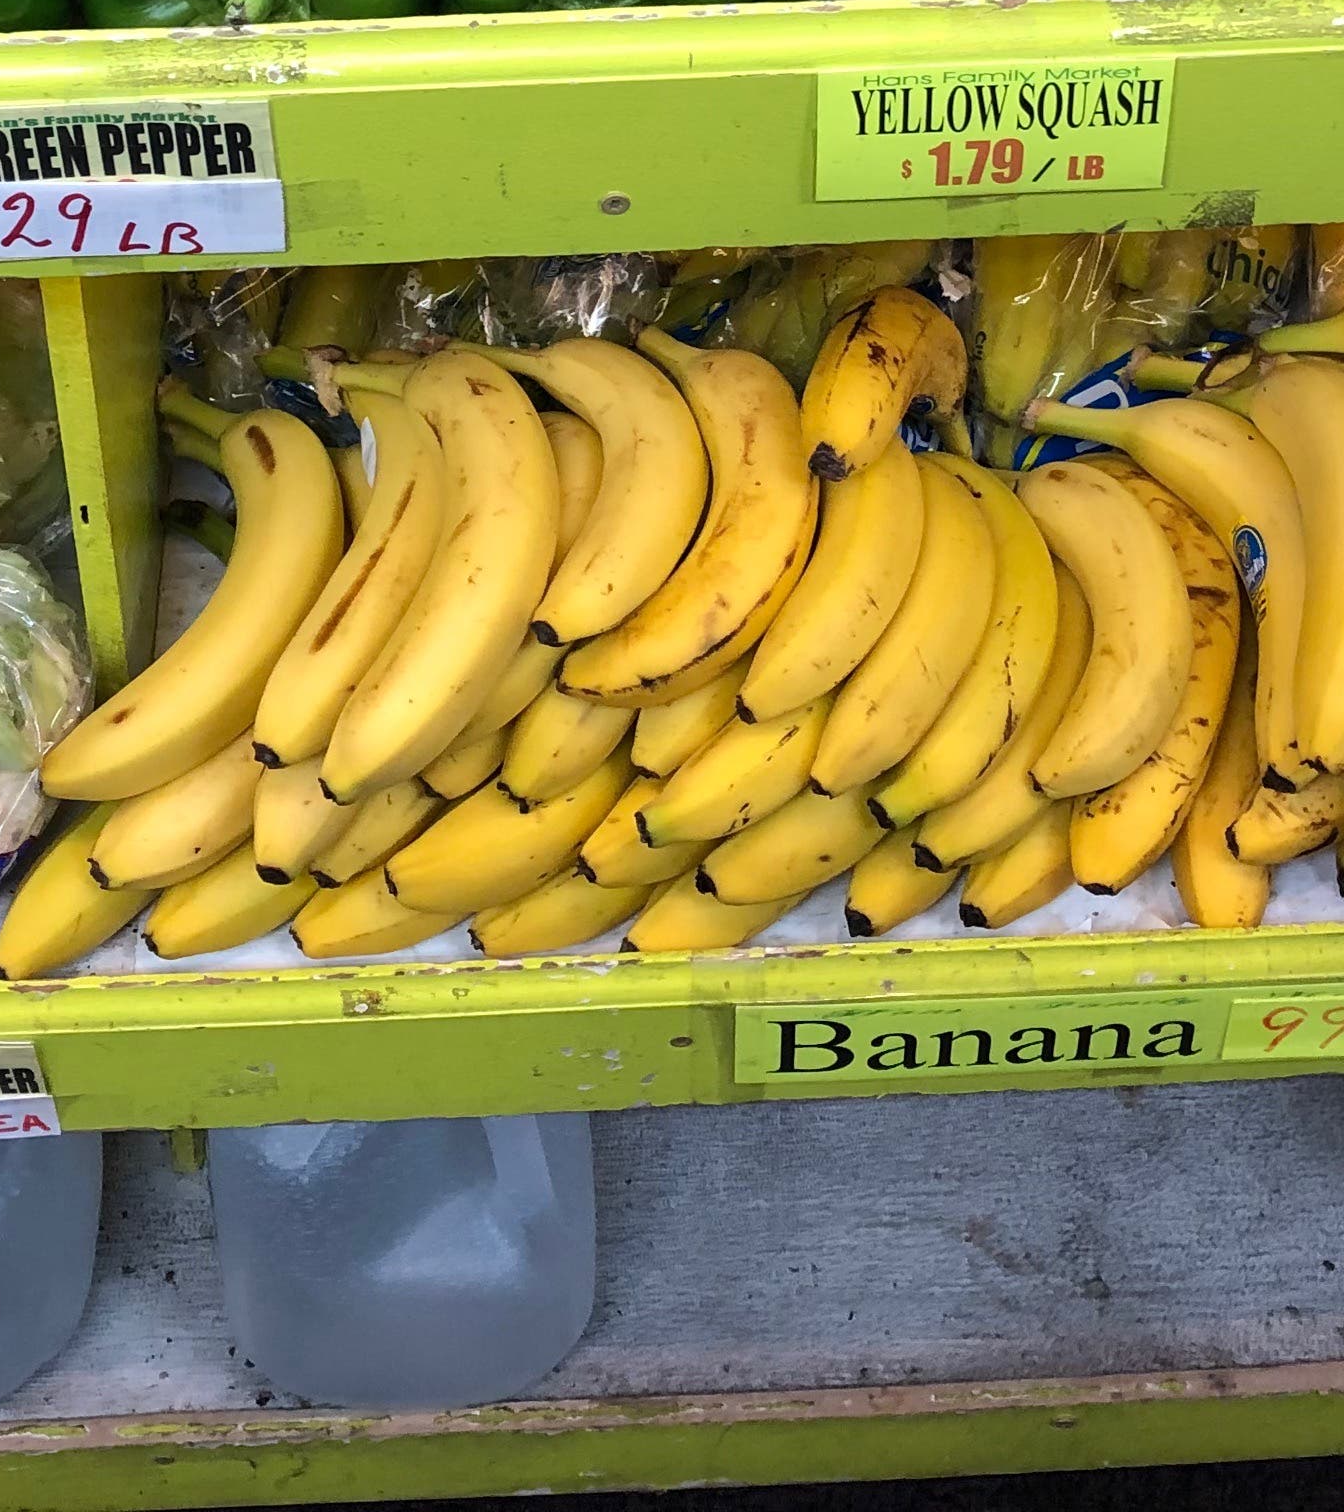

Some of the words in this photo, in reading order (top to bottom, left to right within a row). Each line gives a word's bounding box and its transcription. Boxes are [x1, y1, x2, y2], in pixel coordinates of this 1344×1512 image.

[863, 74, 933, 88] Hans
[943, 70, 1035, 87] Family
[1045, 65, 1143, 81] Market
[44, 113, 124, 127] Family
[131, 111, 217, 125] Market
[851, 84, 1009, 136] YELLOW
[1016, 79, 1164, 140] SQUASH
[97, 122, 256, 177] PEPPER
[119, 222, 204, 255] LB
[766, 1019, 1203, 1074] Banana
